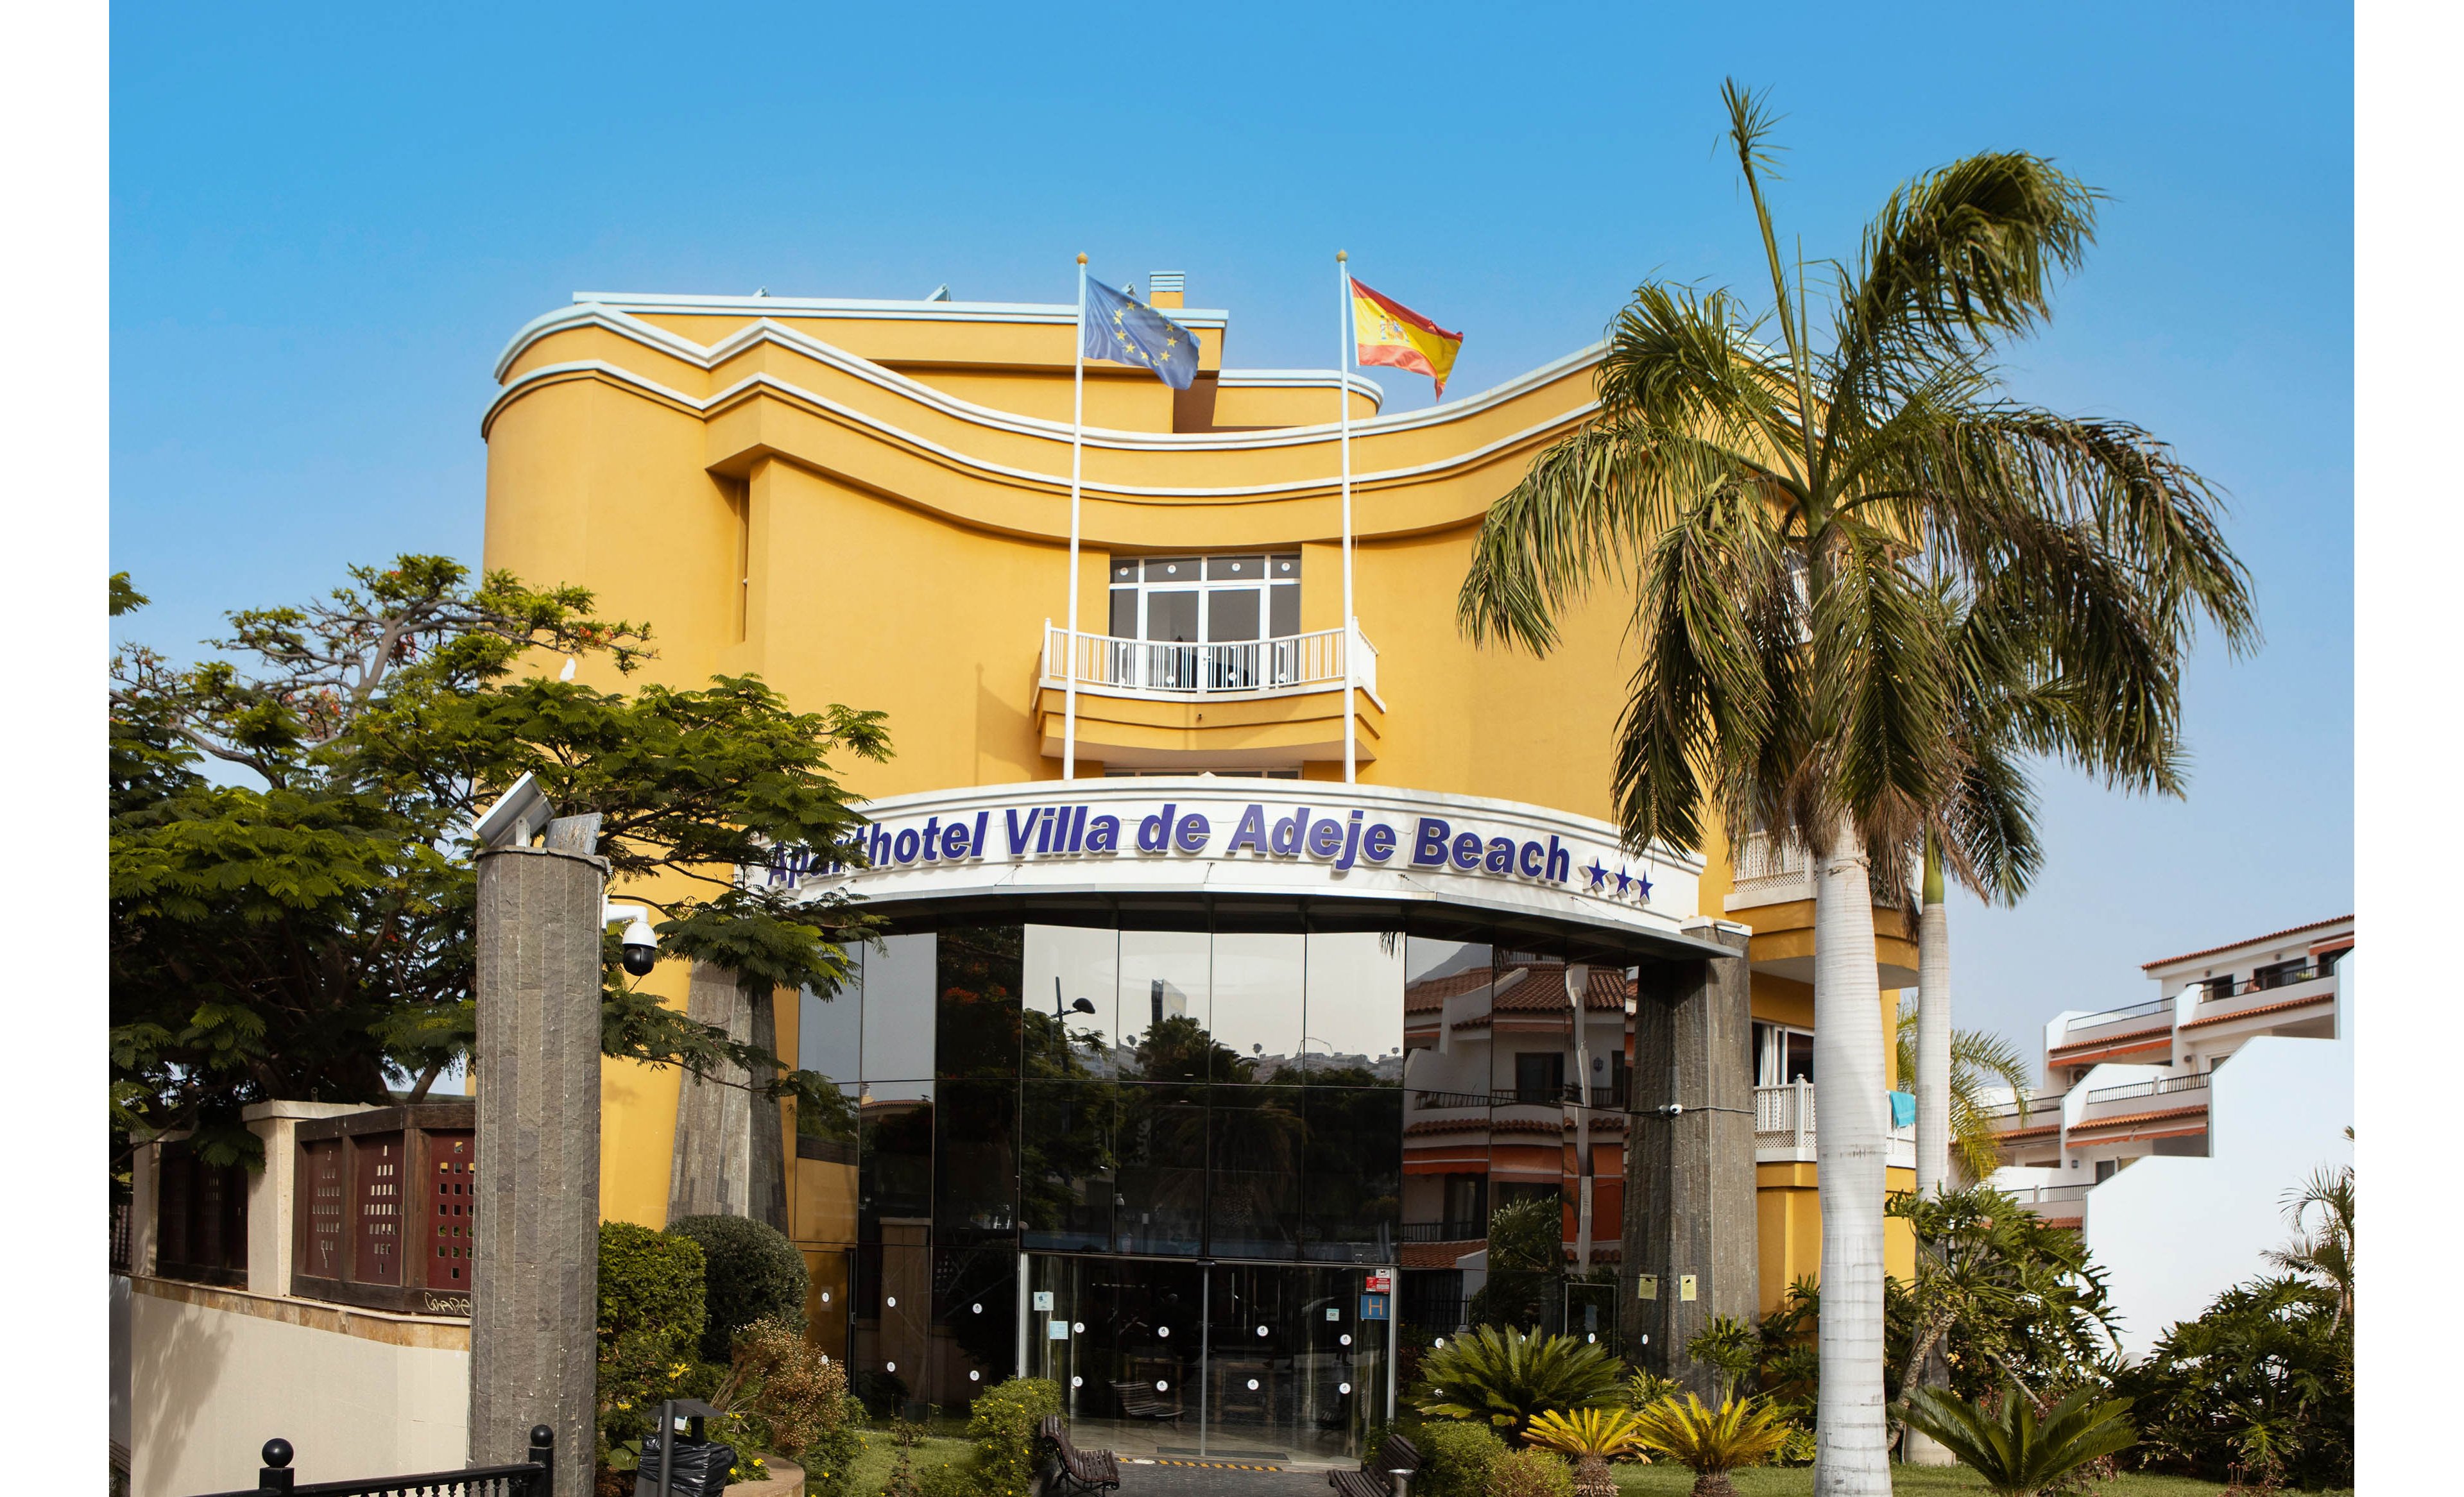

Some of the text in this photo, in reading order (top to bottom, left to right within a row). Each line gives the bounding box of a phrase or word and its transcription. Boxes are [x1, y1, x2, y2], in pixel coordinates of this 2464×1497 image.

[1005, 805, 1120, 855] Villa
[1138, 803, 1210, 851] de
[1228, 803, 1397, 871] Adeje
[1412, 817, 1570, 883] Beach
[1368, 1298, 1383, 1316] H
